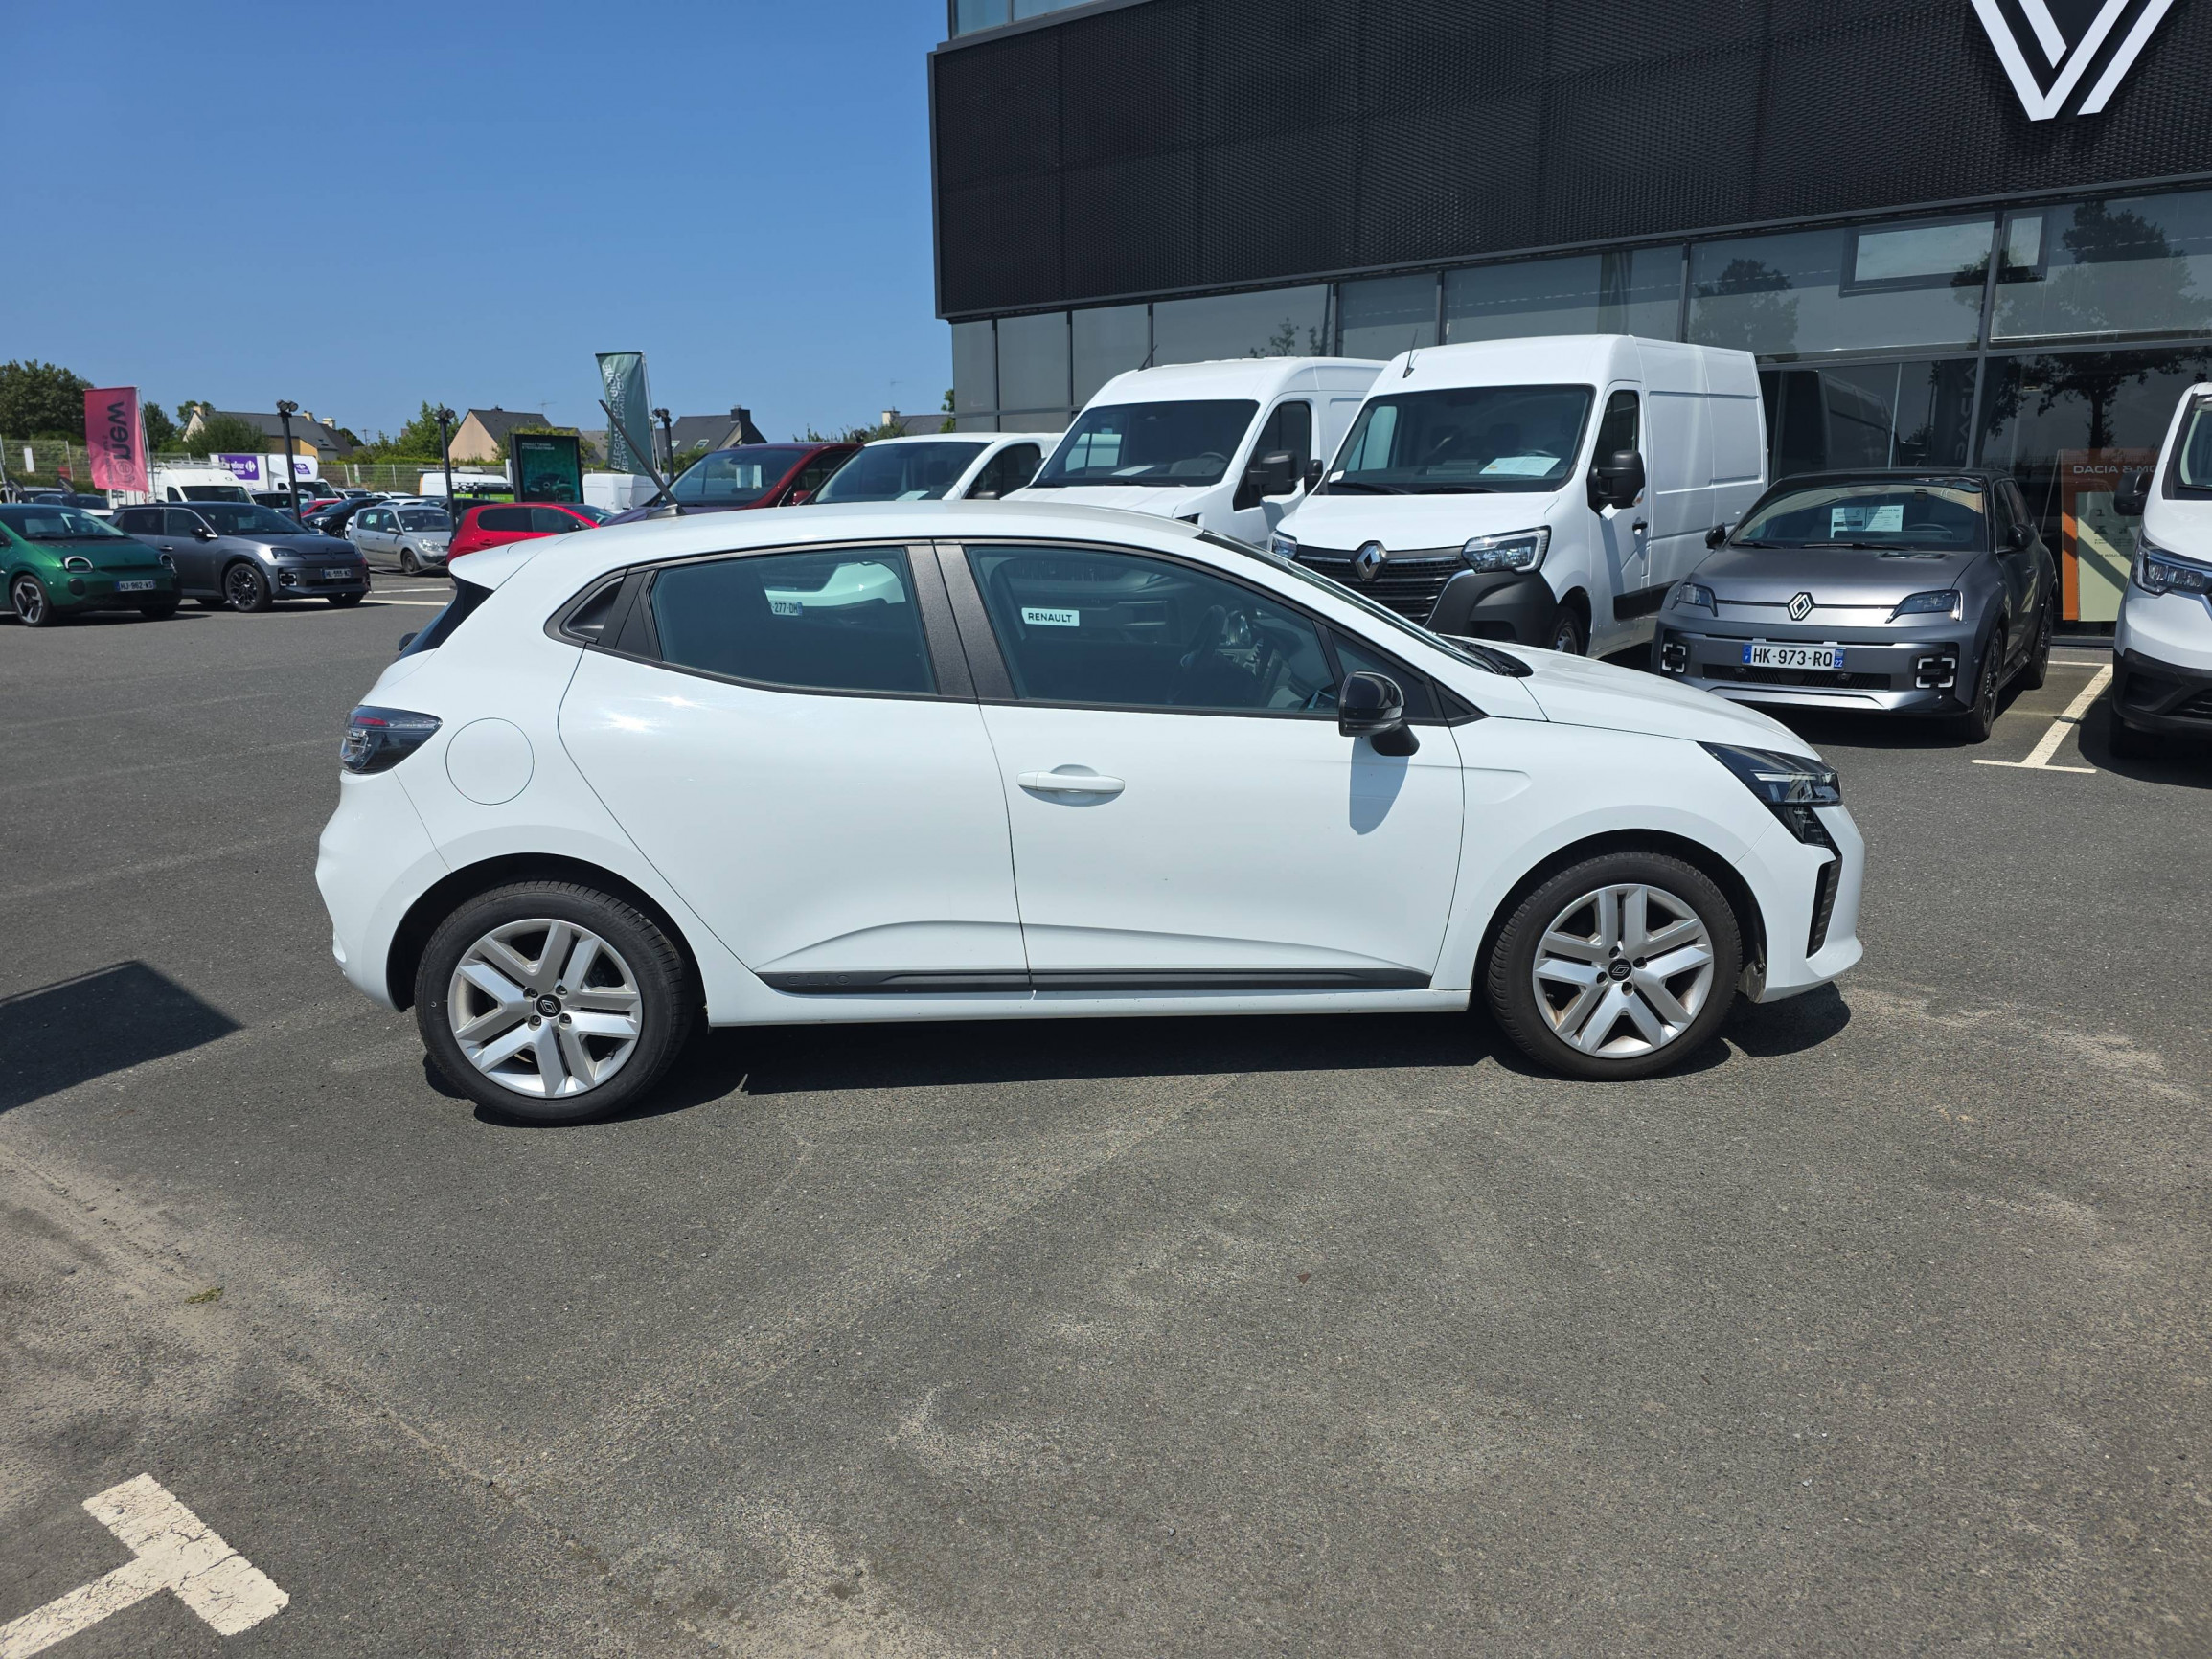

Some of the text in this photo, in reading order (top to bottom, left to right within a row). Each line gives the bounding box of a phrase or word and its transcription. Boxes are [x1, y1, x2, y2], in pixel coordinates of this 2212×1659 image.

[2073, 465, 2118, 474] DACIA
[2123, 465, 2133, 473] &
[1028, 612, 1072, 623] RENAULT
[1753, 648, 1833, 667] HK-973-RQ
[1834, 659, 1843, 668] 22
